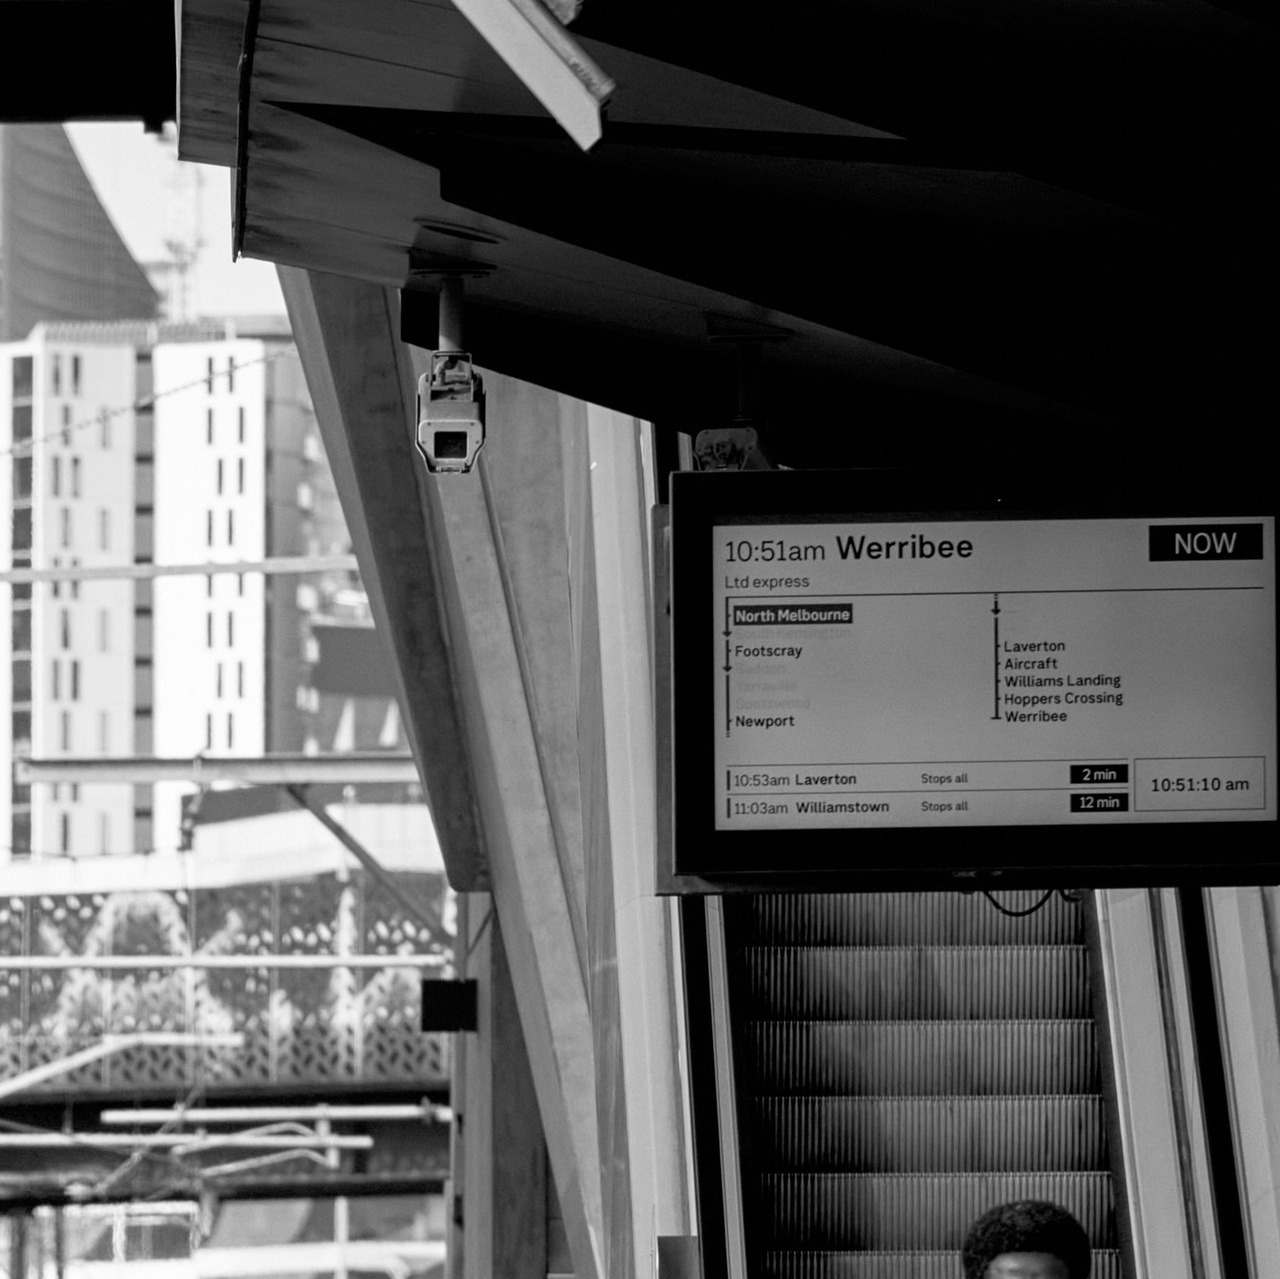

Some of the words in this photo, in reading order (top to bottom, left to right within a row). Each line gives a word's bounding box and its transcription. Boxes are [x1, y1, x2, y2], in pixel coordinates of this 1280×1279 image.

[724, 539, 826, 563] 10:51am
[835, 534, 974, 560] Werribee
[1175, 532, 1237, 555] NOW
[724, 575, 750, 589] Ltd
[753, 576, 811, 591] express
[735, 610, 775, 623] North
[777, 609, 851, 622] Melbourne
[735, 645, 803, 659] Footscray
[1004, 641, 1066, 653] Laverton
[1004, 657, 1058, 670] Aircraft
[1004, 675, 1064, 688] Williams
[1066, 674, 1121, 689] Landing
[1004, 693, 1062, 707] Hoppers
[1064, 691, 1124, 706] Crossing
[735, 715, 795, 730] Newport
[1004, 711, 1068, 723] Werribee
[734, 774, 790, 787] 10:53am
[795, 774, 857, 786] Laverton
[920, 774, 953, 785] Stops
[954, 773, 969, 784] all
[1082, 768, 1091, 781] 2
[1093, 769, 1117, 781] min
[1151, 778, 1221, 792] 10:51:10
[1225, 779, 1250, 791] am
[734, 802, 788, 816] 11:03am
[796, 801, 890, 815] Williamstown
[920, 801, 953, 813] Stops
[954, 801, 969, 812] all
[1079, 796, 1094, 809] 12
[1096, 796, 1120, 809] min
